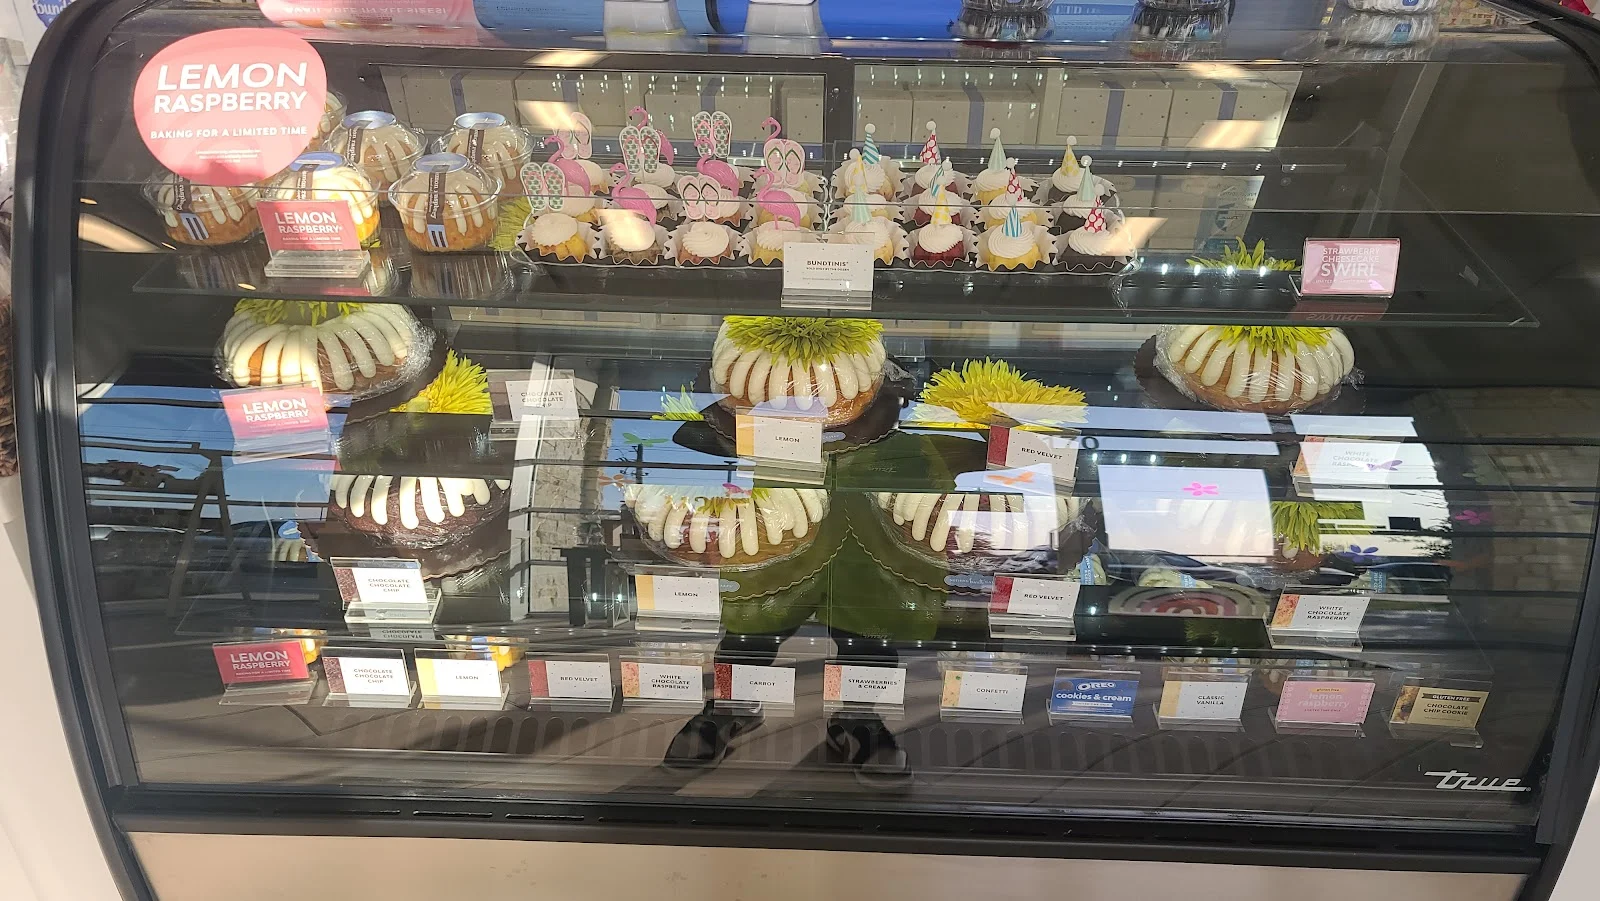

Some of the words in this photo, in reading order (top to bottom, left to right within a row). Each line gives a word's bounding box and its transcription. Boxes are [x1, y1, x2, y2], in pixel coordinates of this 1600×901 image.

[157, 62, 308, 91] LEMON
[154, 90, 308, 114] RASPBERRY
[150, 130, 193, 139] BAKING
[197, 128, 218, 138] FOR
[222, 128, 230, 137] A
[233, 128, 278, 136] LIMITED
[280, 126, 308, 135] TIME
[274, 212, 336, 224] LEMON
[1321, 263, 1378, 277] SWIRL
[242, 398, 307, 415] LEMON
[246, 409, 309, 423] RASPBERRY
[1036, 451, 1062, 460] VELVET
[230, 650, 289, 663] LEMON
[232, 661, 290, 670] RASPBERRY
[1078, 682, 1115, 690] OREO
[1298, 700, 1349, 708] raspberry
[1424, 770, 1528, 791] true
